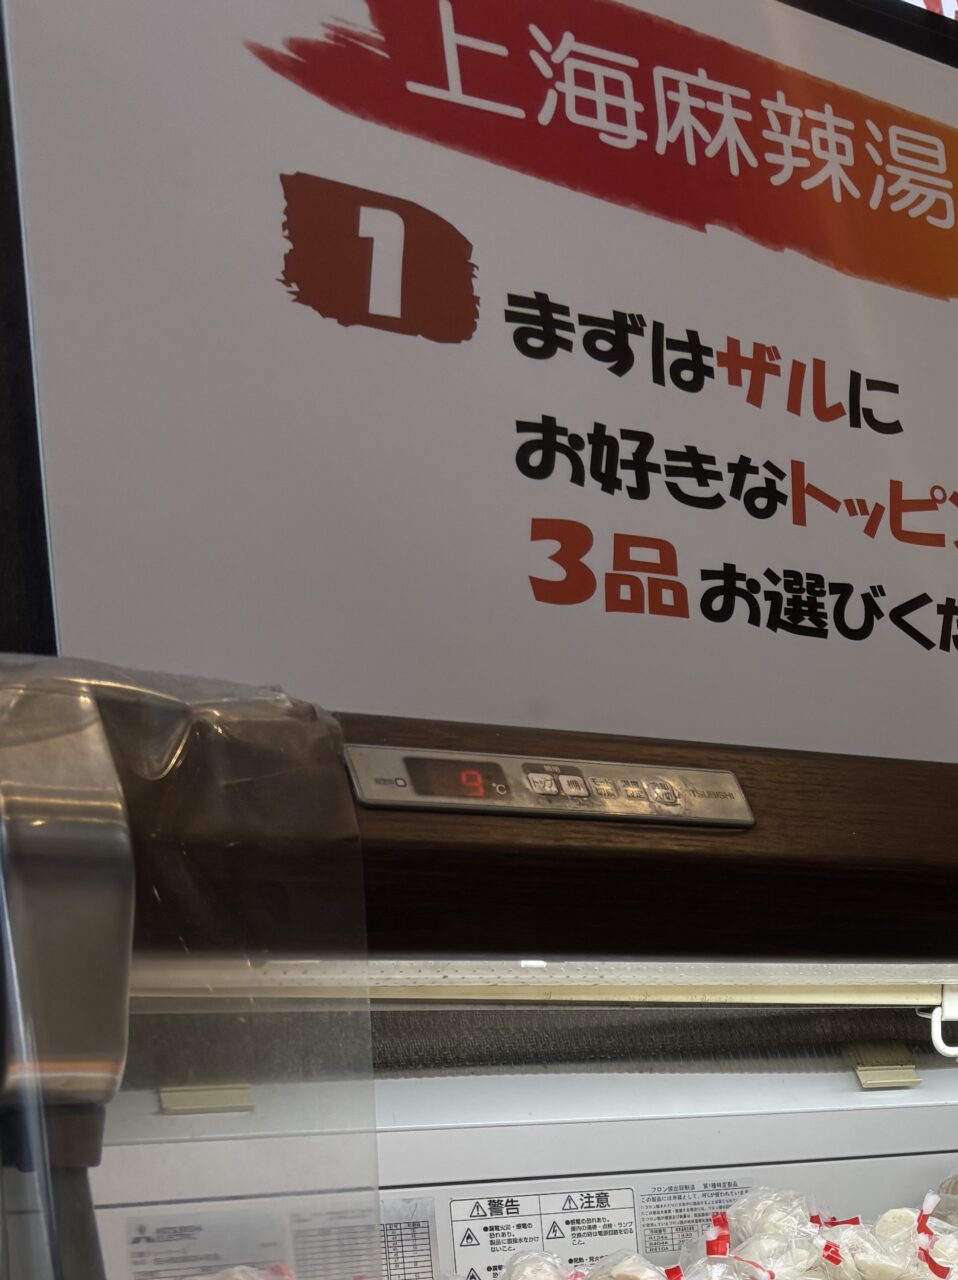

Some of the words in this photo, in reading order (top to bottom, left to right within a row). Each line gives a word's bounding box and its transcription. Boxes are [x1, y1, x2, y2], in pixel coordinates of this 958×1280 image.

[358, 205, 406, 319] 1
[504, 290, 904, 435] まずはザルに
[487, 1198, 521, 1217] 警告
[579, 1192, 611, 1210] 注意
